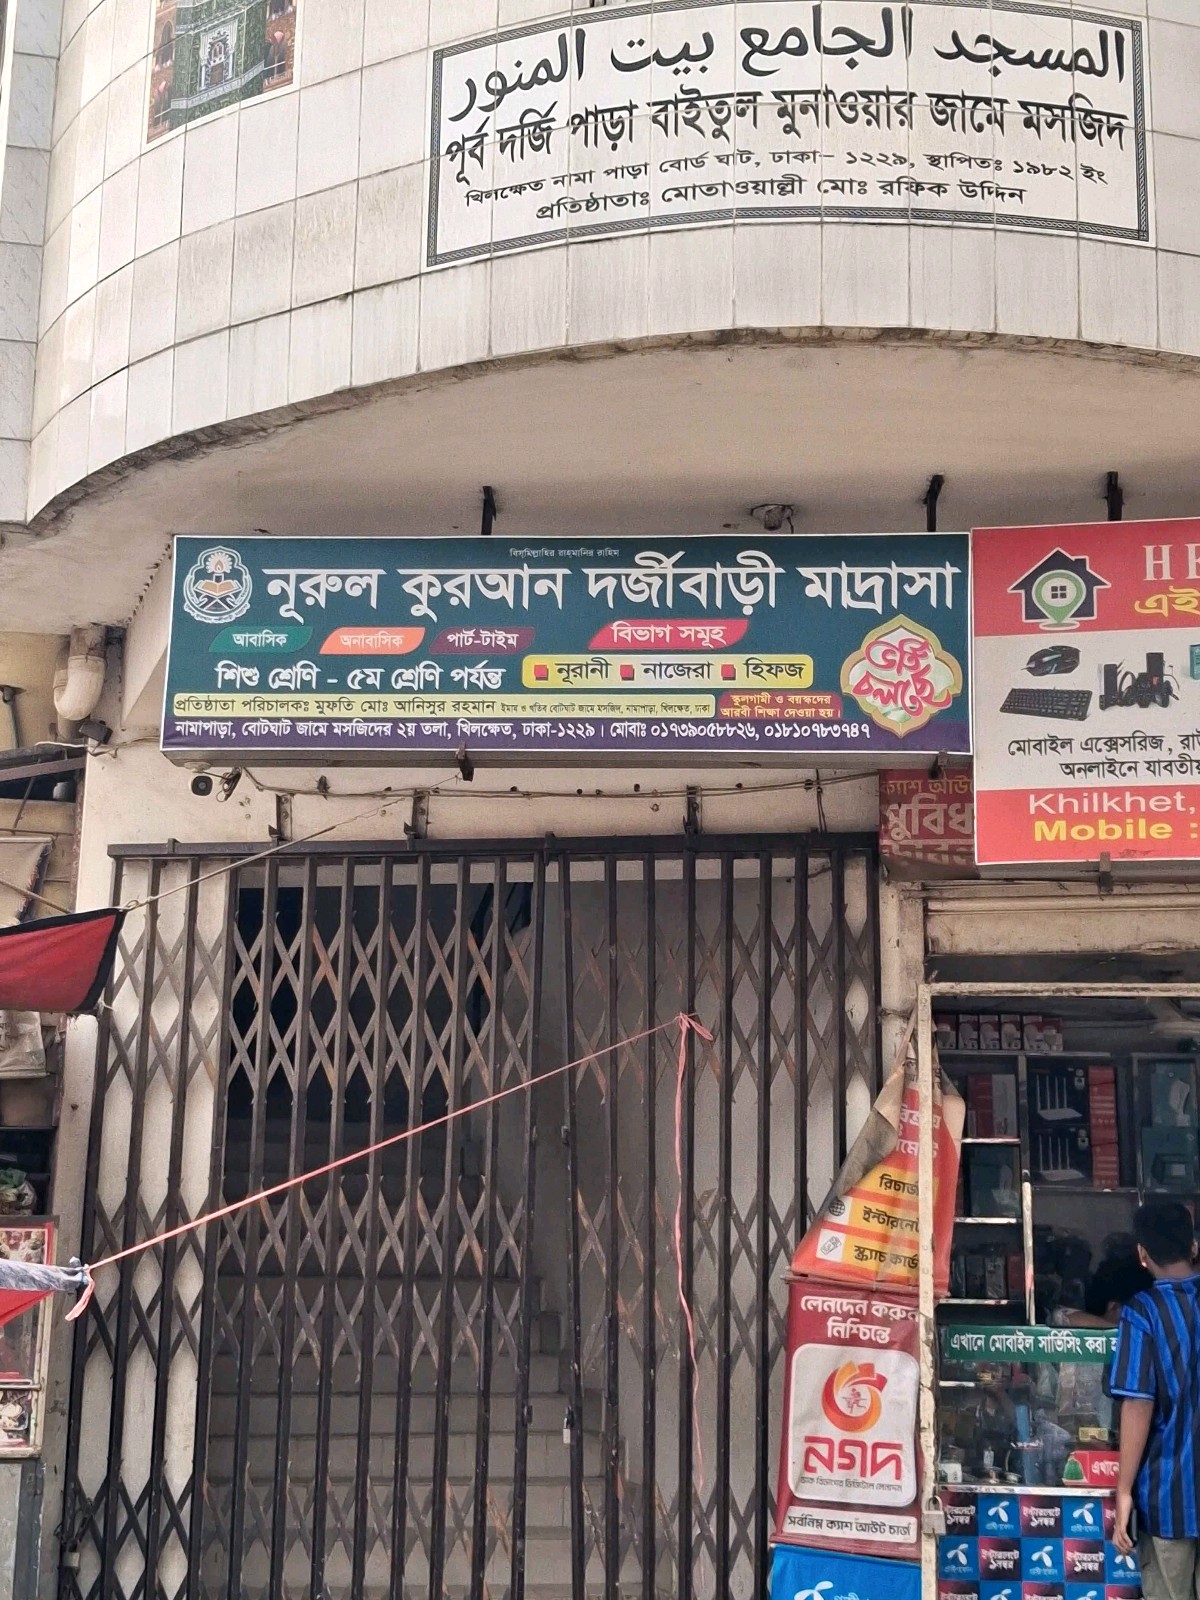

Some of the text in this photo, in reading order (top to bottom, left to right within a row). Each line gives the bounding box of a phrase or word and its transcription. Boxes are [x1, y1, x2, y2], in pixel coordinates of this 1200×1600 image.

[448, 4, 1125, 122] المسجد الجامع بيت المنور
[446, 84, 1129, 184] পূর্ব দর্জি পাড়া বাইতুল মুনাওয়ার জামে মসজিদ
[465, 178, 545, 207] খিলক্ষেত
[551, 169, 595, 188] নামা
[603, 162, 650, 180] পাড়া
[659, 151, 710, 173] বোর্ড
[713, 149, 760, 168] ঘাট,
[846, 151, 915, 169] ১২২৯,
[924, 151, 1003, 172] স্থাপিতঃ
[1013, 159, 1074, 181] ১৯৮২
[1080, 163, 1108, 184] ইং
[536, 174, 1028, 220] প্রতিষ্ঠাতাঃ মোতাওয়াল্লী মোঃ রফিক উদ্দিন
[261, 550, 962, 624] নূরুল কুরআন দর্জীবাড়ী মাদ্রাসা
[233, 629, 288, 648] আবাসিক
[340, 630, 404, 648] অনাবাসিক
[447, 628, 519, 649] পার্ট-টাইম
[611, 621, 727, 648] বিভাগ সমূহ
[214, 660, 260, 690] শিশু
[269, 660, 322, 690] শ্রেণি
[347, 668, 385, 690] ৫ম
[391, 660, 444, 690] শ্রেণি
[450, 660, 507, 690] পর্যন্ত
[554, 657, 806, 684] নূরানী নাজেরা হিফজ
[175, 697, 235, 712] প্রতিষ্ঠাতা
[241, 696, 309, 713] পরিচালকঃ
[315, 697, 354, 715] মুফতি
[361, 701, 389, 713] মোঃ
[394, 697, 446, 715] আনিসুর
[452, 700, 496, 713] রহমান
[175, 720, 236, 739] নামাপাড়া,
[242, 718, 292, 736] বোটঘাট
[297, 722, 328, 736] জামে
[332, 718, 391, 737] মসজিদের
[397, 723, 415, 737] ২য়
[420, 722, 452, 739] তলা,
[457, 718, 517, 739] খিলক্ষেত,
[522, 722, 595, 738] ঢাকা-১২২৯
[610, 722, 647, 738] মোবাঃ
[651, 723, 760, 740] ০১৭৩৯০৫৮৮২৬,
[764, 723, 870, 739] ০১৮১০৭৮৩৭৪৭
[1008, 735, 1073, 756] মোবাইল
[1060, 757, 1139, 779] অনলাইনে
[1029, 791, 1195, 815] Khilkhet,
[1033, 819, 1173, 842] Mobile
[801, 1295, 920, 1323] লেনদেন করুন
[827, 1318, 891, 1345] নিশ্চিন্তে
[951, 1332, 985, 1350] এখানে
[989, 1331, 1034, 1353] মোবাইল
[1038, 1330, 1082, 1354] সার্ভিসিং
[1085, 1336, 1107, 1355] করা
[803, 1436, 904, 1481] নগদ
[826, 1519, 853, 1531] ক্যাশ
[855, 1520, 887, 1534] আউট
